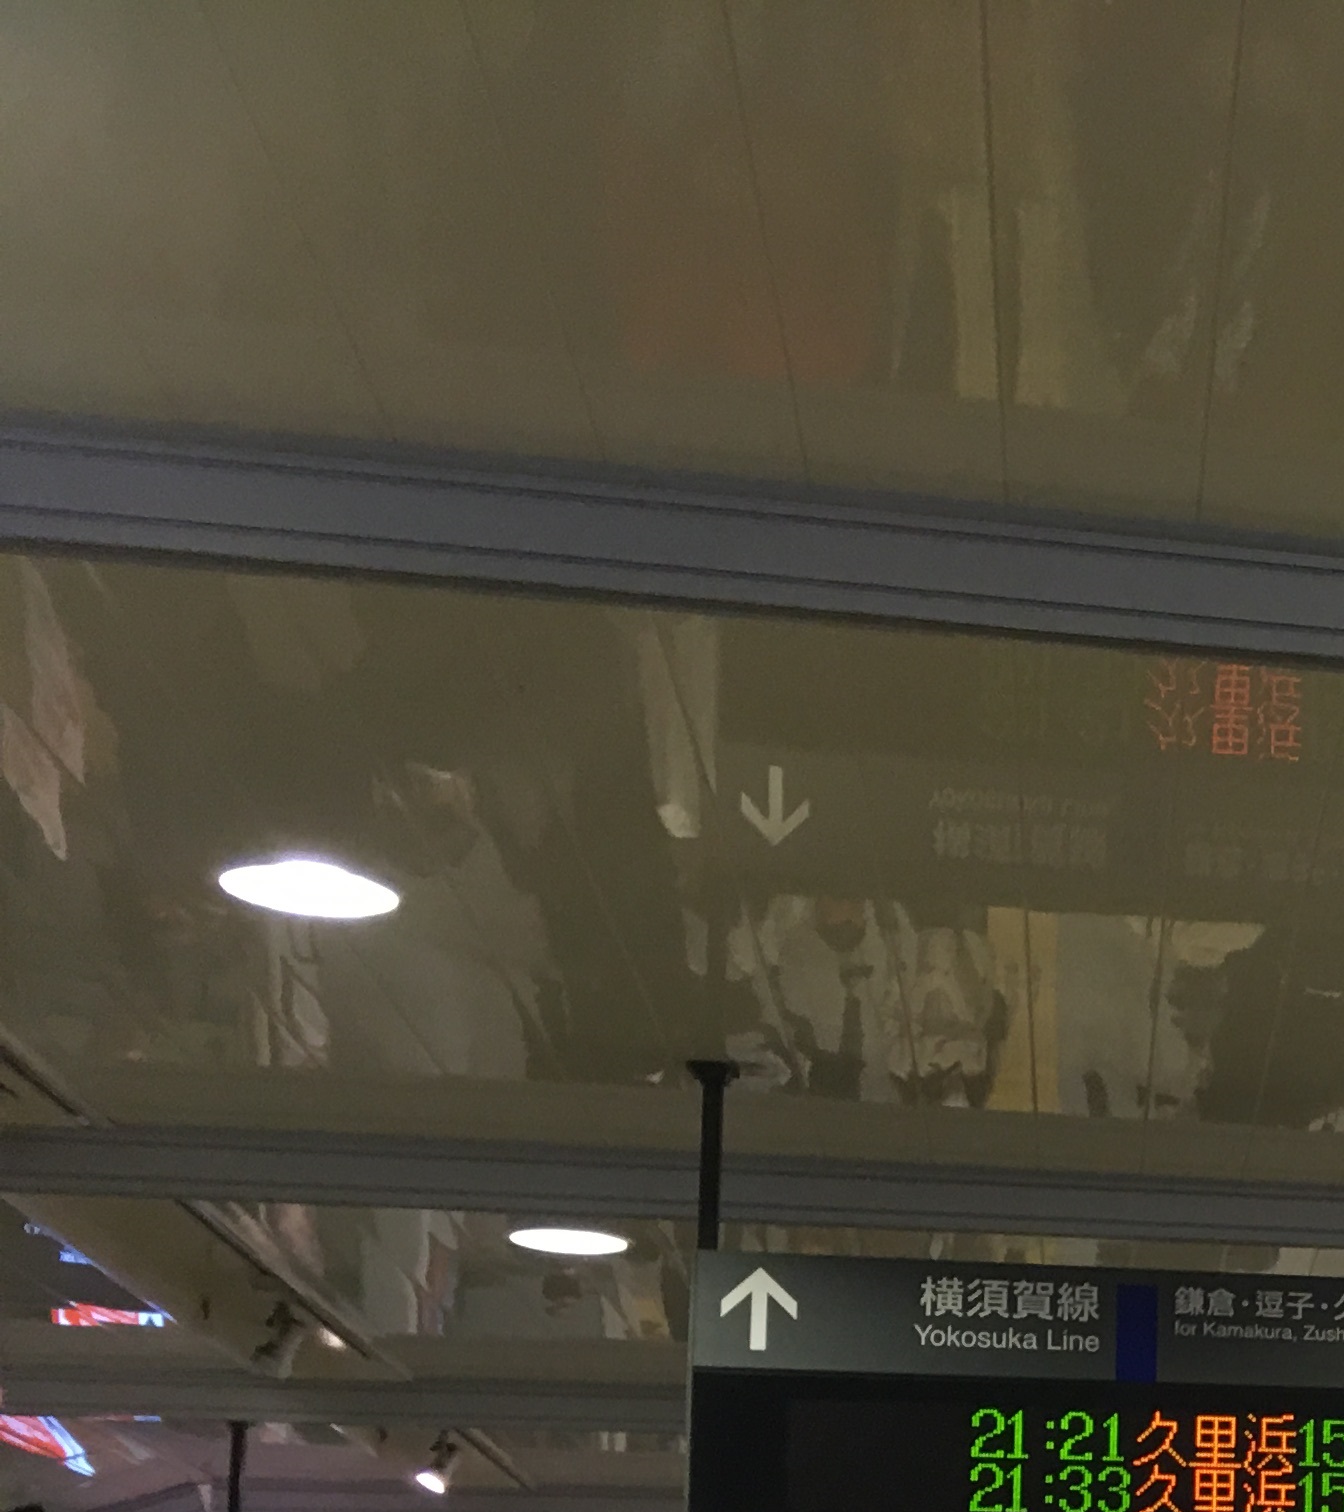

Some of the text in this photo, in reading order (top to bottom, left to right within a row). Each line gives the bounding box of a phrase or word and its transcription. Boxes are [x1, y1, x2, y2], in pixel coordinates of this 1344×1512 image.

[920, 1277, 1098, 1322] 横須賀線
[914, 1324, 1099, 1352] Yokosuka Line
[1175, 1322, 1198, 1337] for
[1203, 1323, 1297, 1342] Kamakura,
[1133, 1411, 1297, 1473] 久里浜
